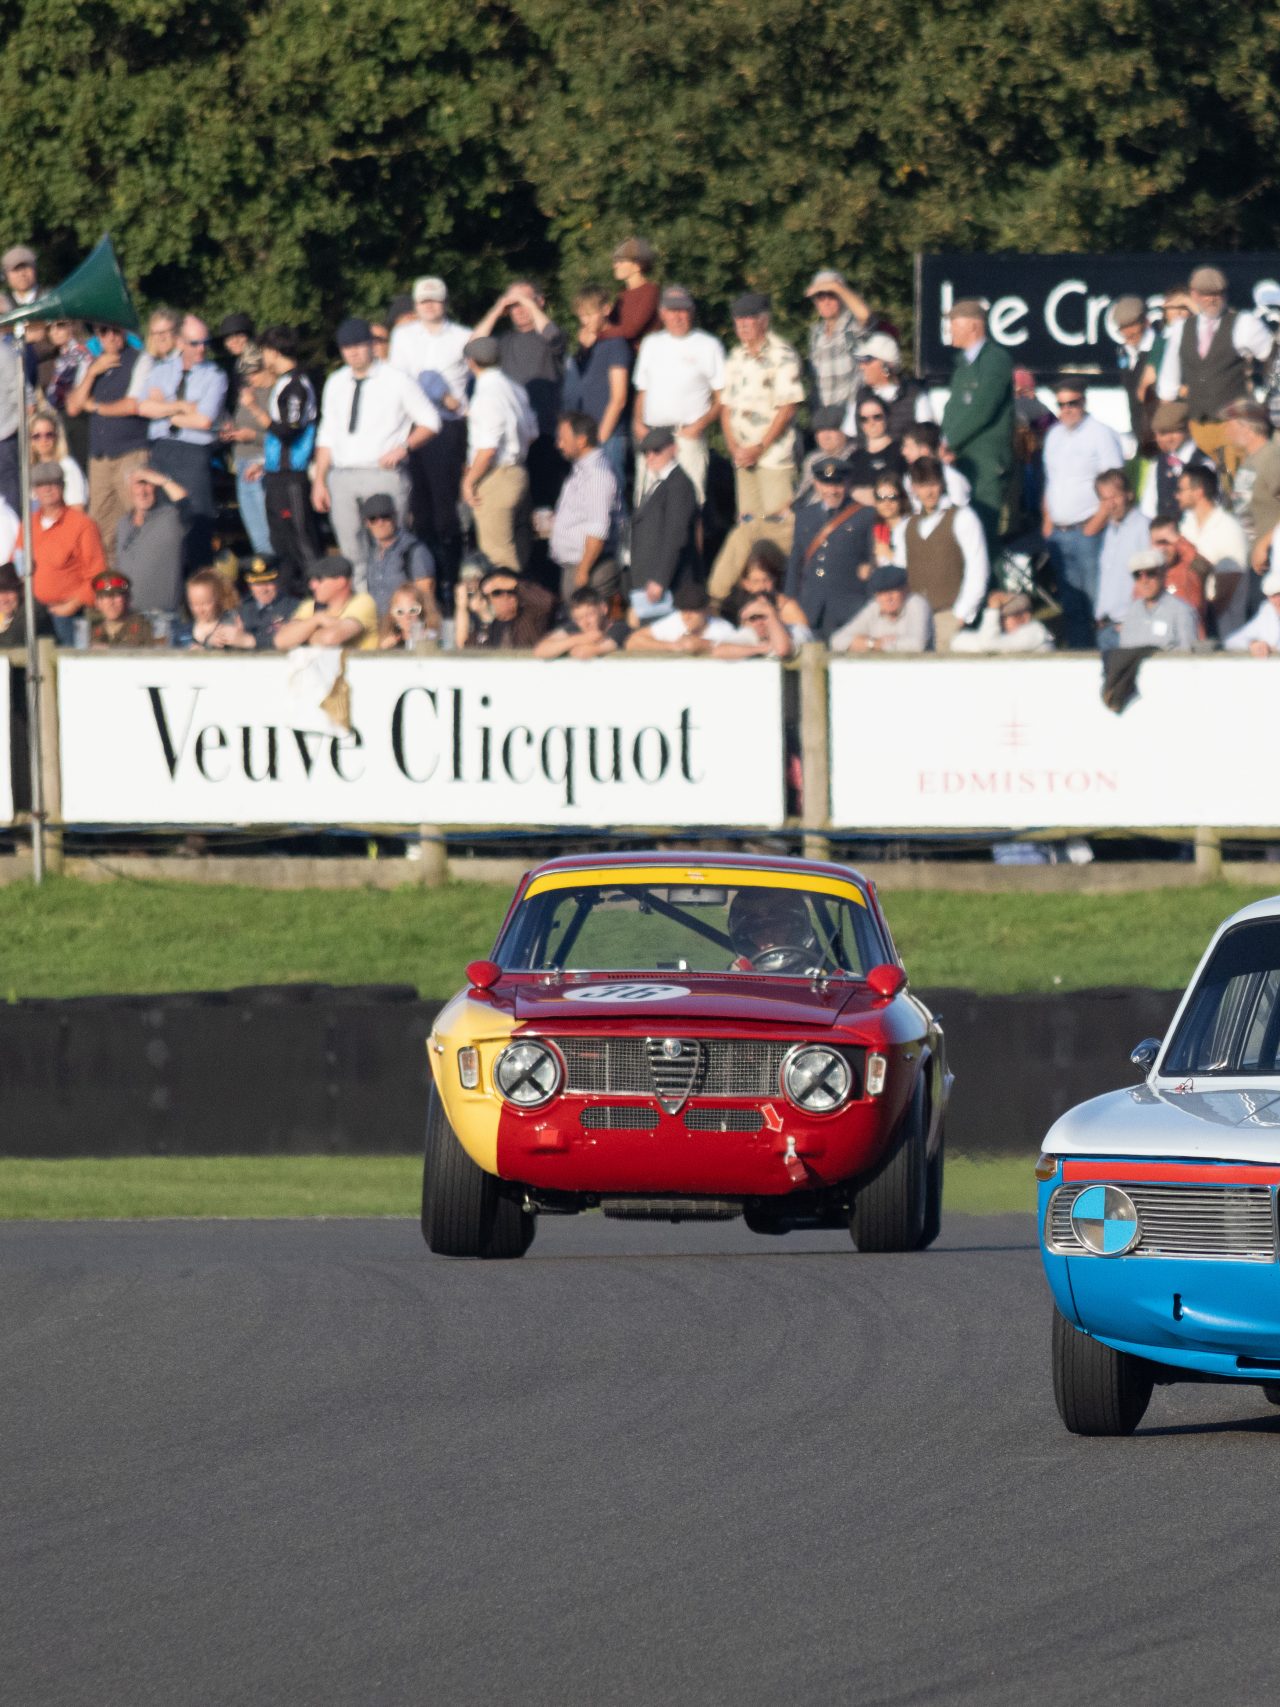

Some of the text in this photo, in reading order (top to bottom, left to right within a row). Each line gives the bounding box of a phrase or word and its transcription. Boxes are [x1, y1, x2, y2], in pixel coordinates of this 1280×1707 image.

[940, 280, 1029, 346] Ie
[140, 686, 706, 807] Veuve Clicquot
[917, 769, 1119, 794] EDMISTON
[578, 985, 675, 1000] 36
